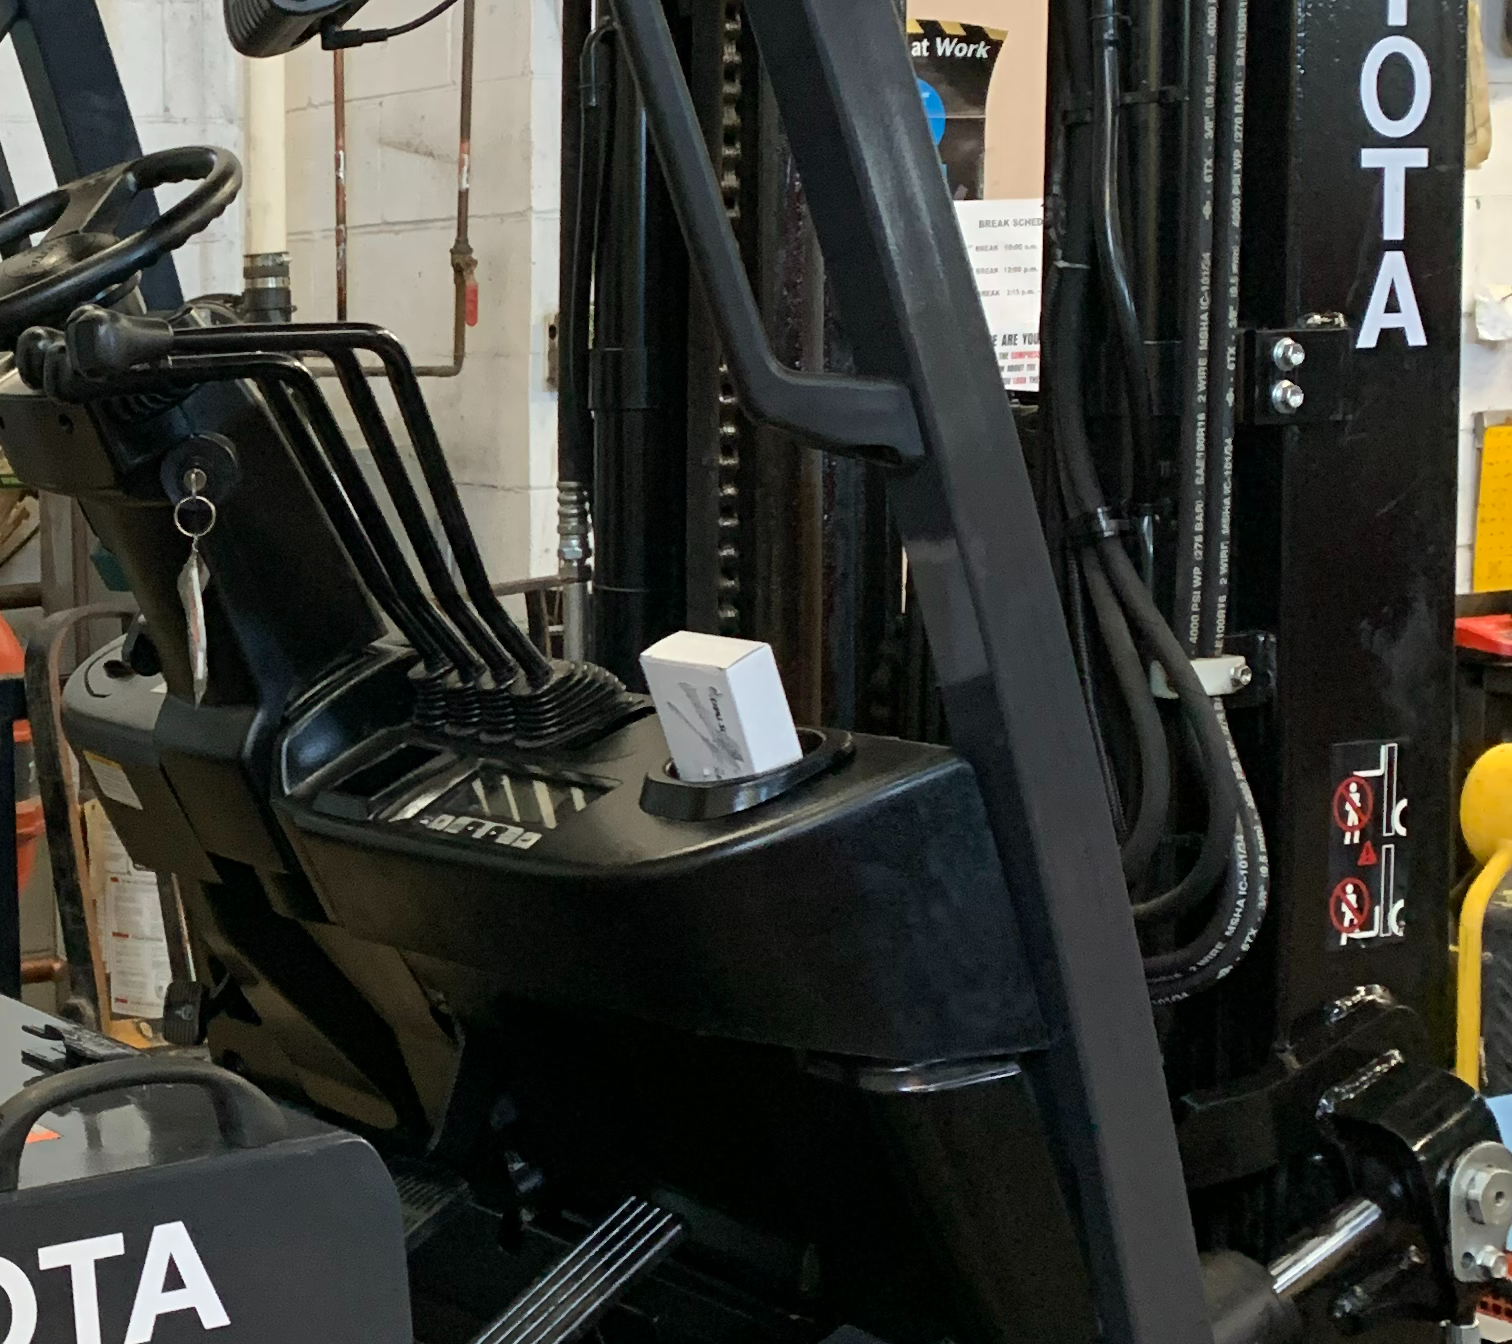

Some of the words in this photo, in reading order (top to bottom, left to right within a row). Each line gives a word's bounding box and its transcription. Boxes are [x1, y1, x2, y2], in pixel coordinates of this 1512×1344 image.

[911, 38, 930, 57] at
[935, 36, 991, 59] Work
[1012, 217, 1044, 228] SCHED
[1001, 333, 1018, 347] ARE
[1224, 898, 1246, 936] MSHA
